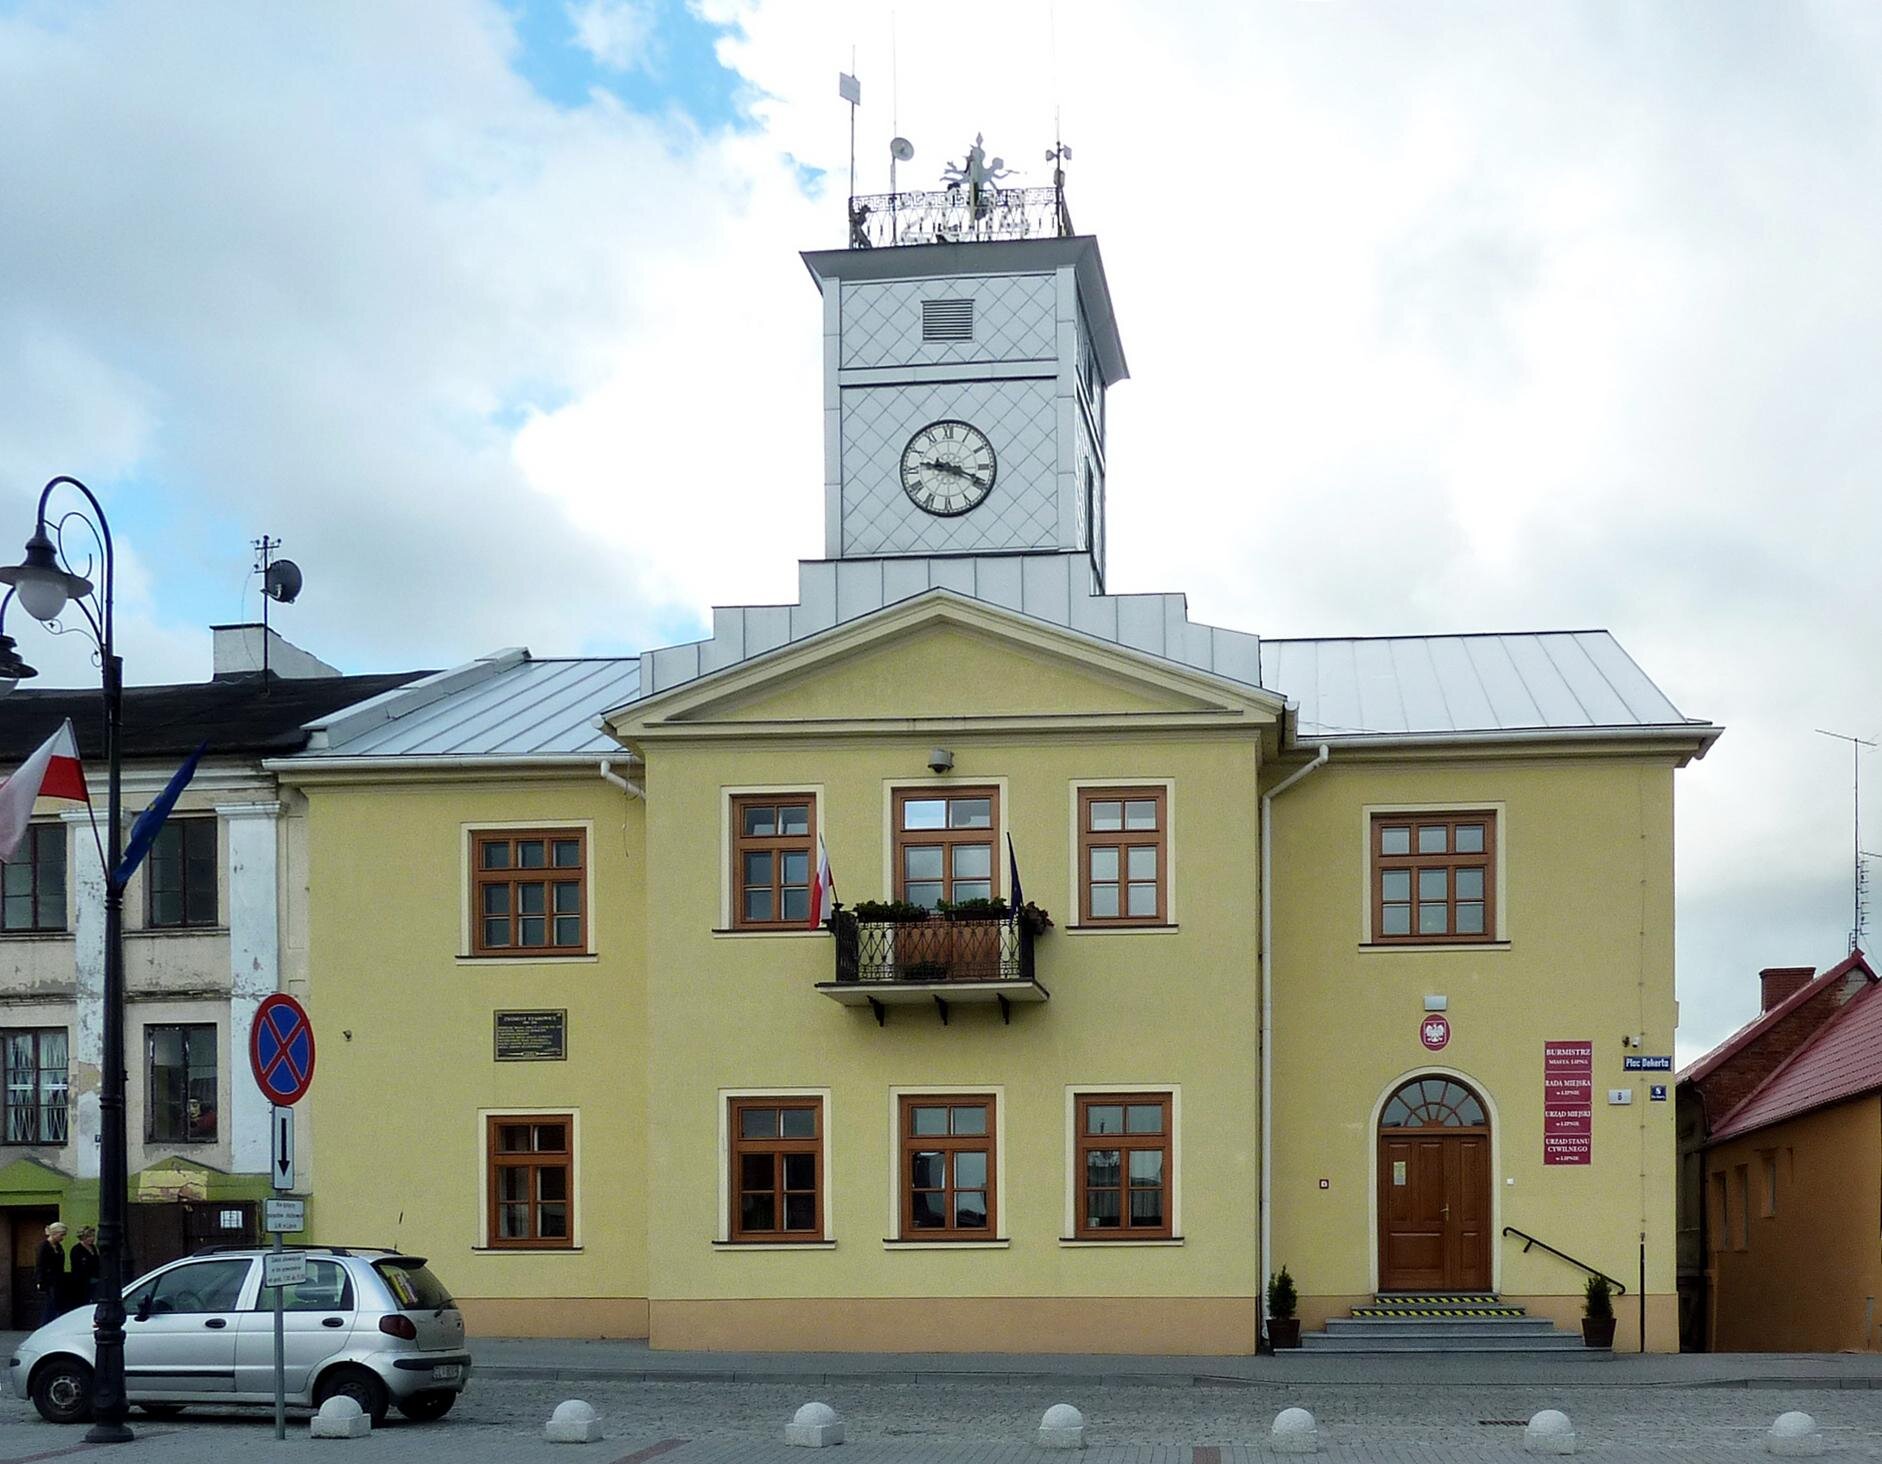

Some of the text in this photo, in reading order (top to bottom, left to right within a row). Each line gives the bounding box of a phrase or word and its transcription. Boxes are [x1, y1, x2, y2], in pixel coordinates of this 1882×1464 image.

[1546, 1048, 1591, 1056] BURMISTRZ
[1625, 1058, 1669, 1068] Plac Dekerta
[1564, 1079, 1591, 1087] MIEJSKA
[1567, 1110, 1591, 1118] MIEJSKI
